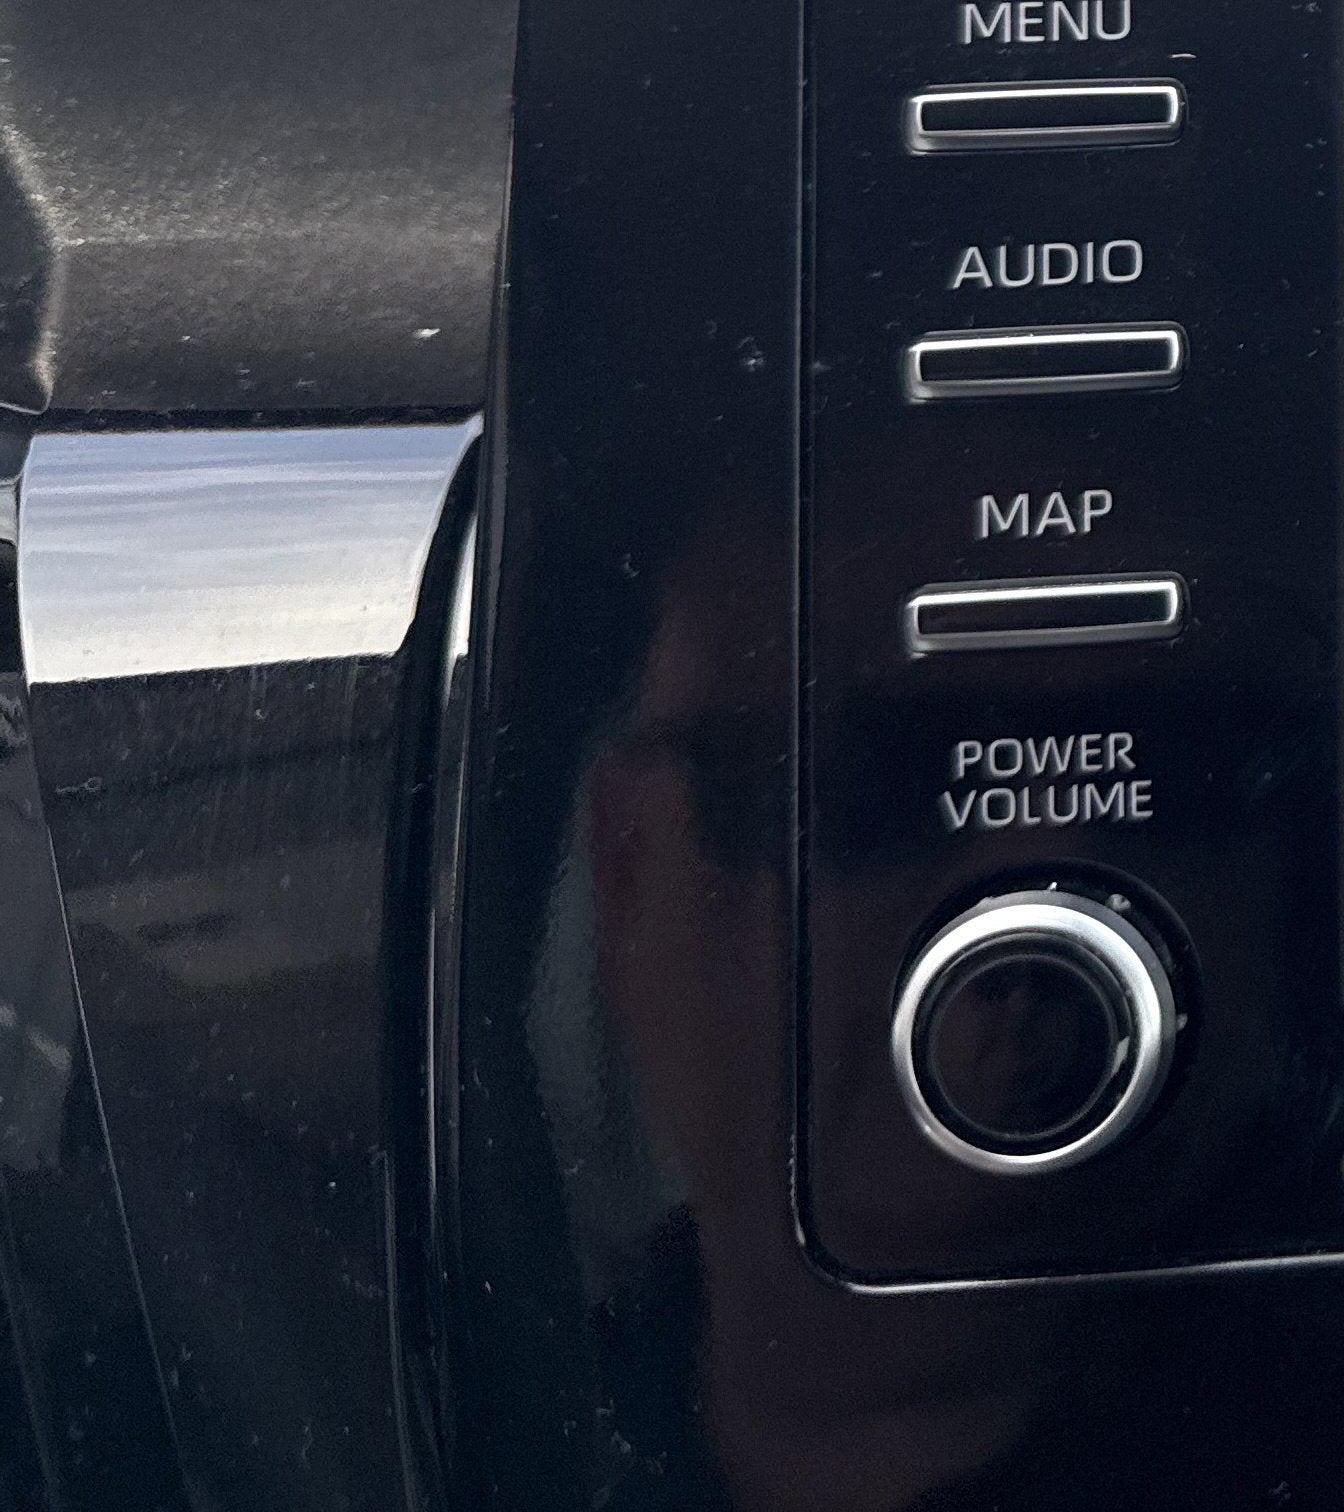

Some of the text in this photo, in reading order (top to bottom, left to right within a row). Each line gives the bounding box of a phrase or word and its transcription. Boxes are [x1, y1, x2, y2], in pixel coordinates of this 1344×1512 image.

[951, 239, 1143, 289] AUDIO
[980, 489, 1113, 539] MAP
[954, 732, 1136, 779] POWER
[941, 779, 1154, 829] VOLUME
